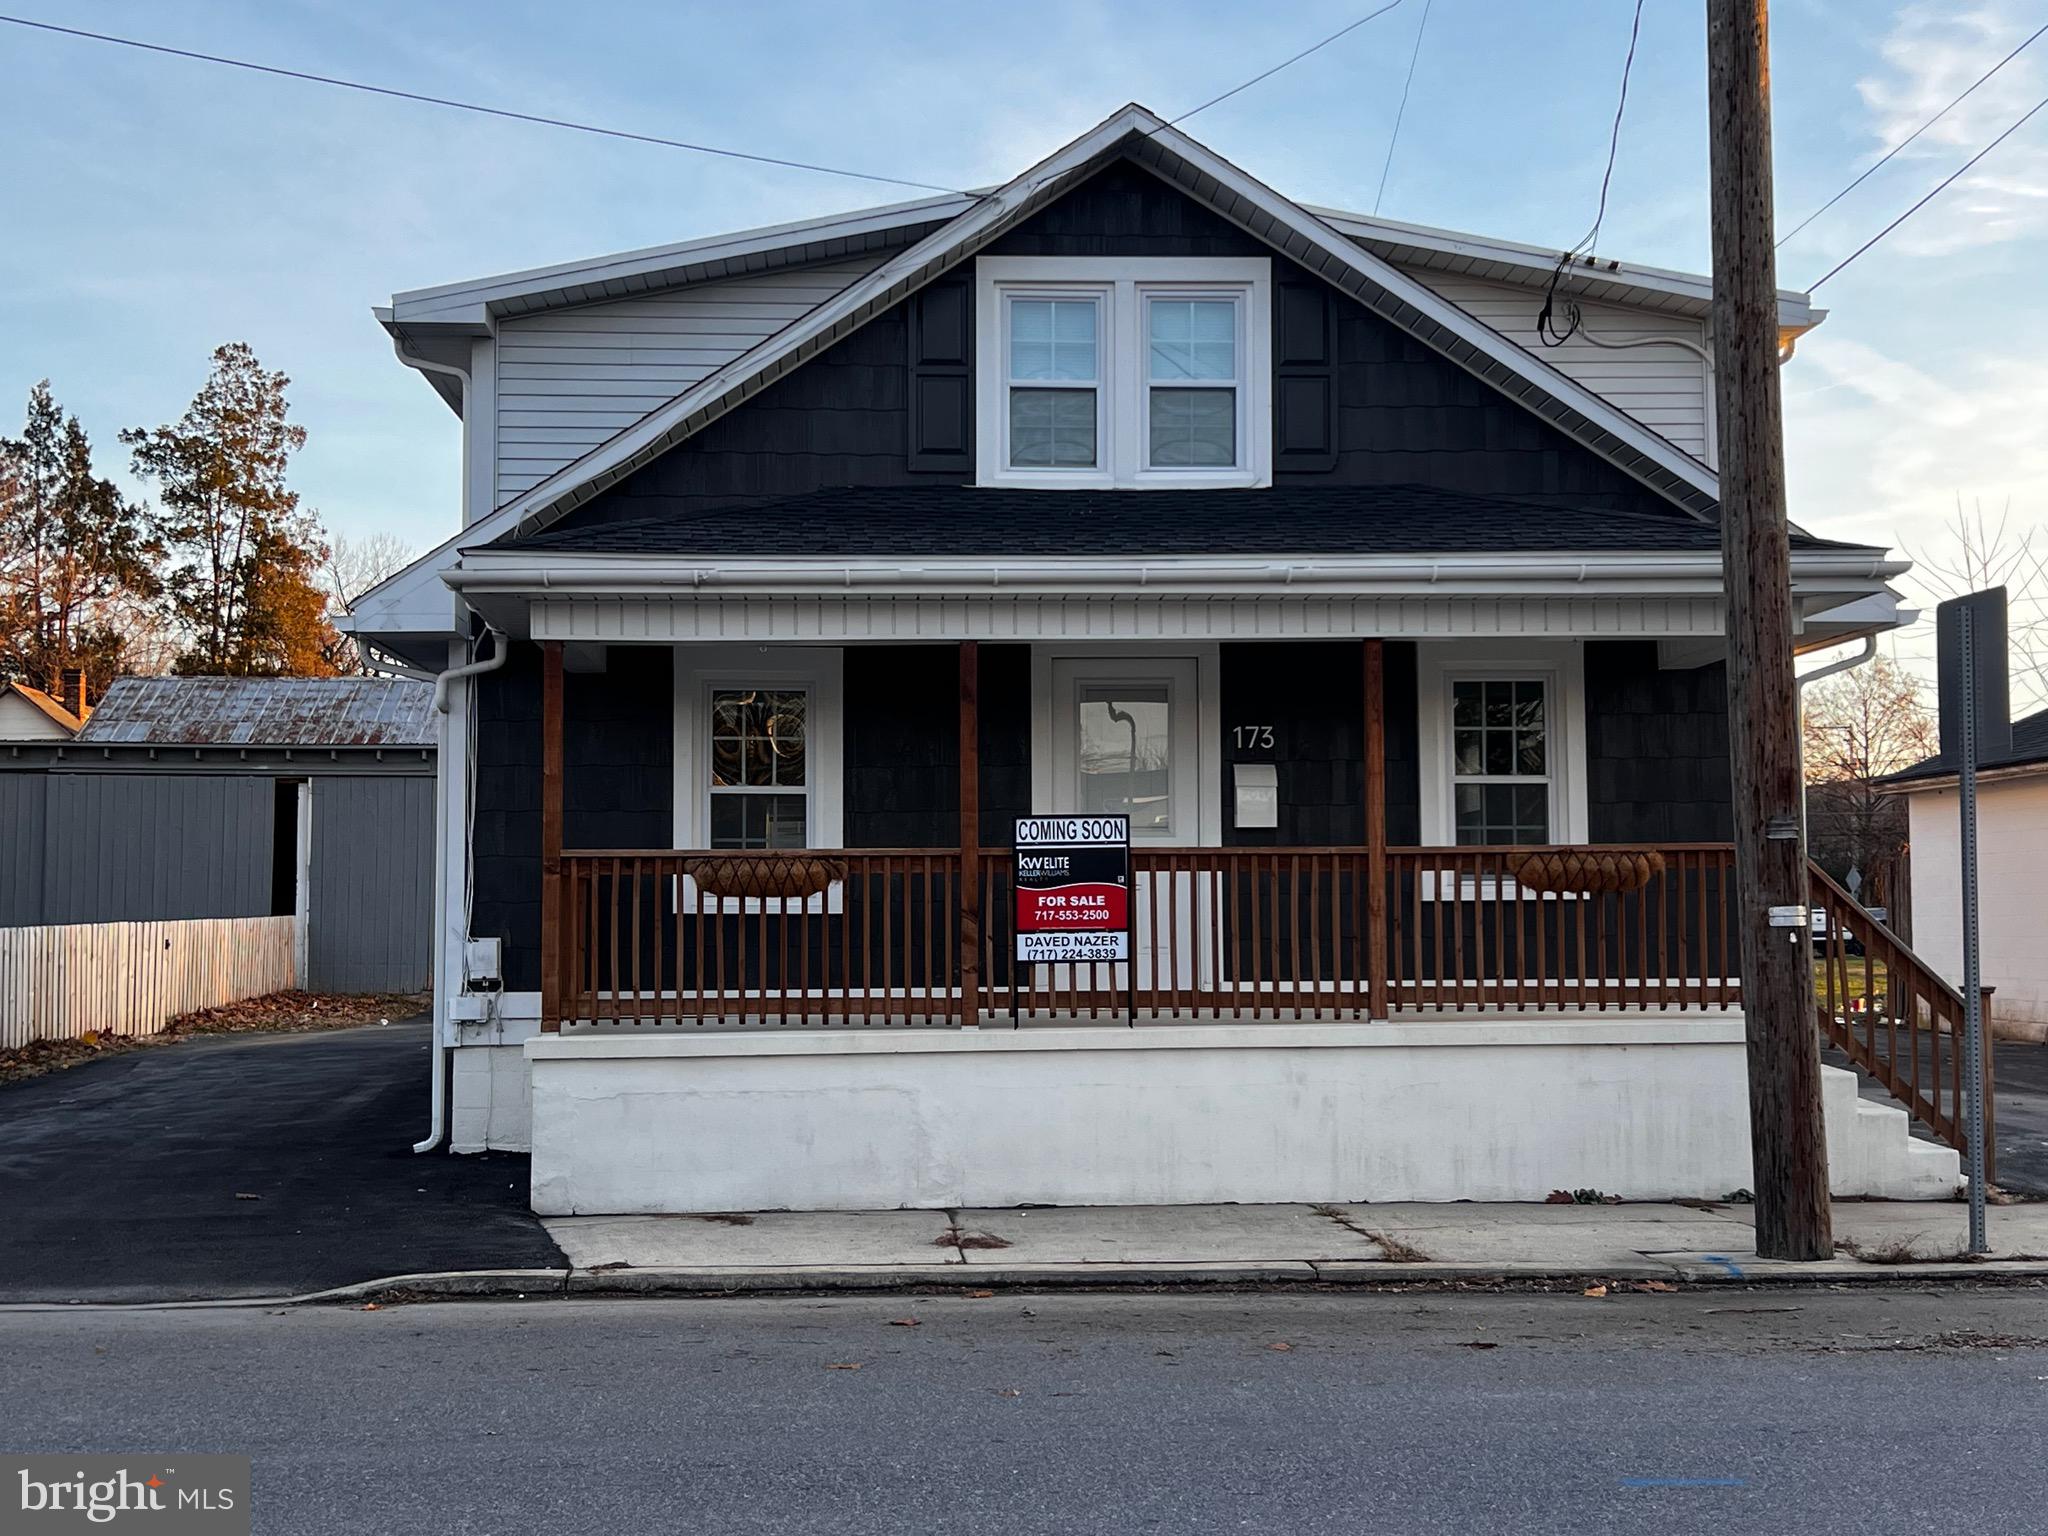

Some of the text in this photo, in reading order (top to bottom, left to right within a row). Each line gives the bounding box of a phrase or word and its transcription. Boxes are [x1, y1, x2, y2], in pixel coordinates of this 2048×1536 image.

[1233, 726, 1275, 749] 173
[1018, 820, 1124, 841] COMING SOON
[1038, 895, 1106, 907] FOR SALE
[1034, 909, 1109, 921] 717-553-2500
[1025, 935, 1119, 947] DAVED NAZER
[1027, 948, 1117, 960] (717) 224-3839
